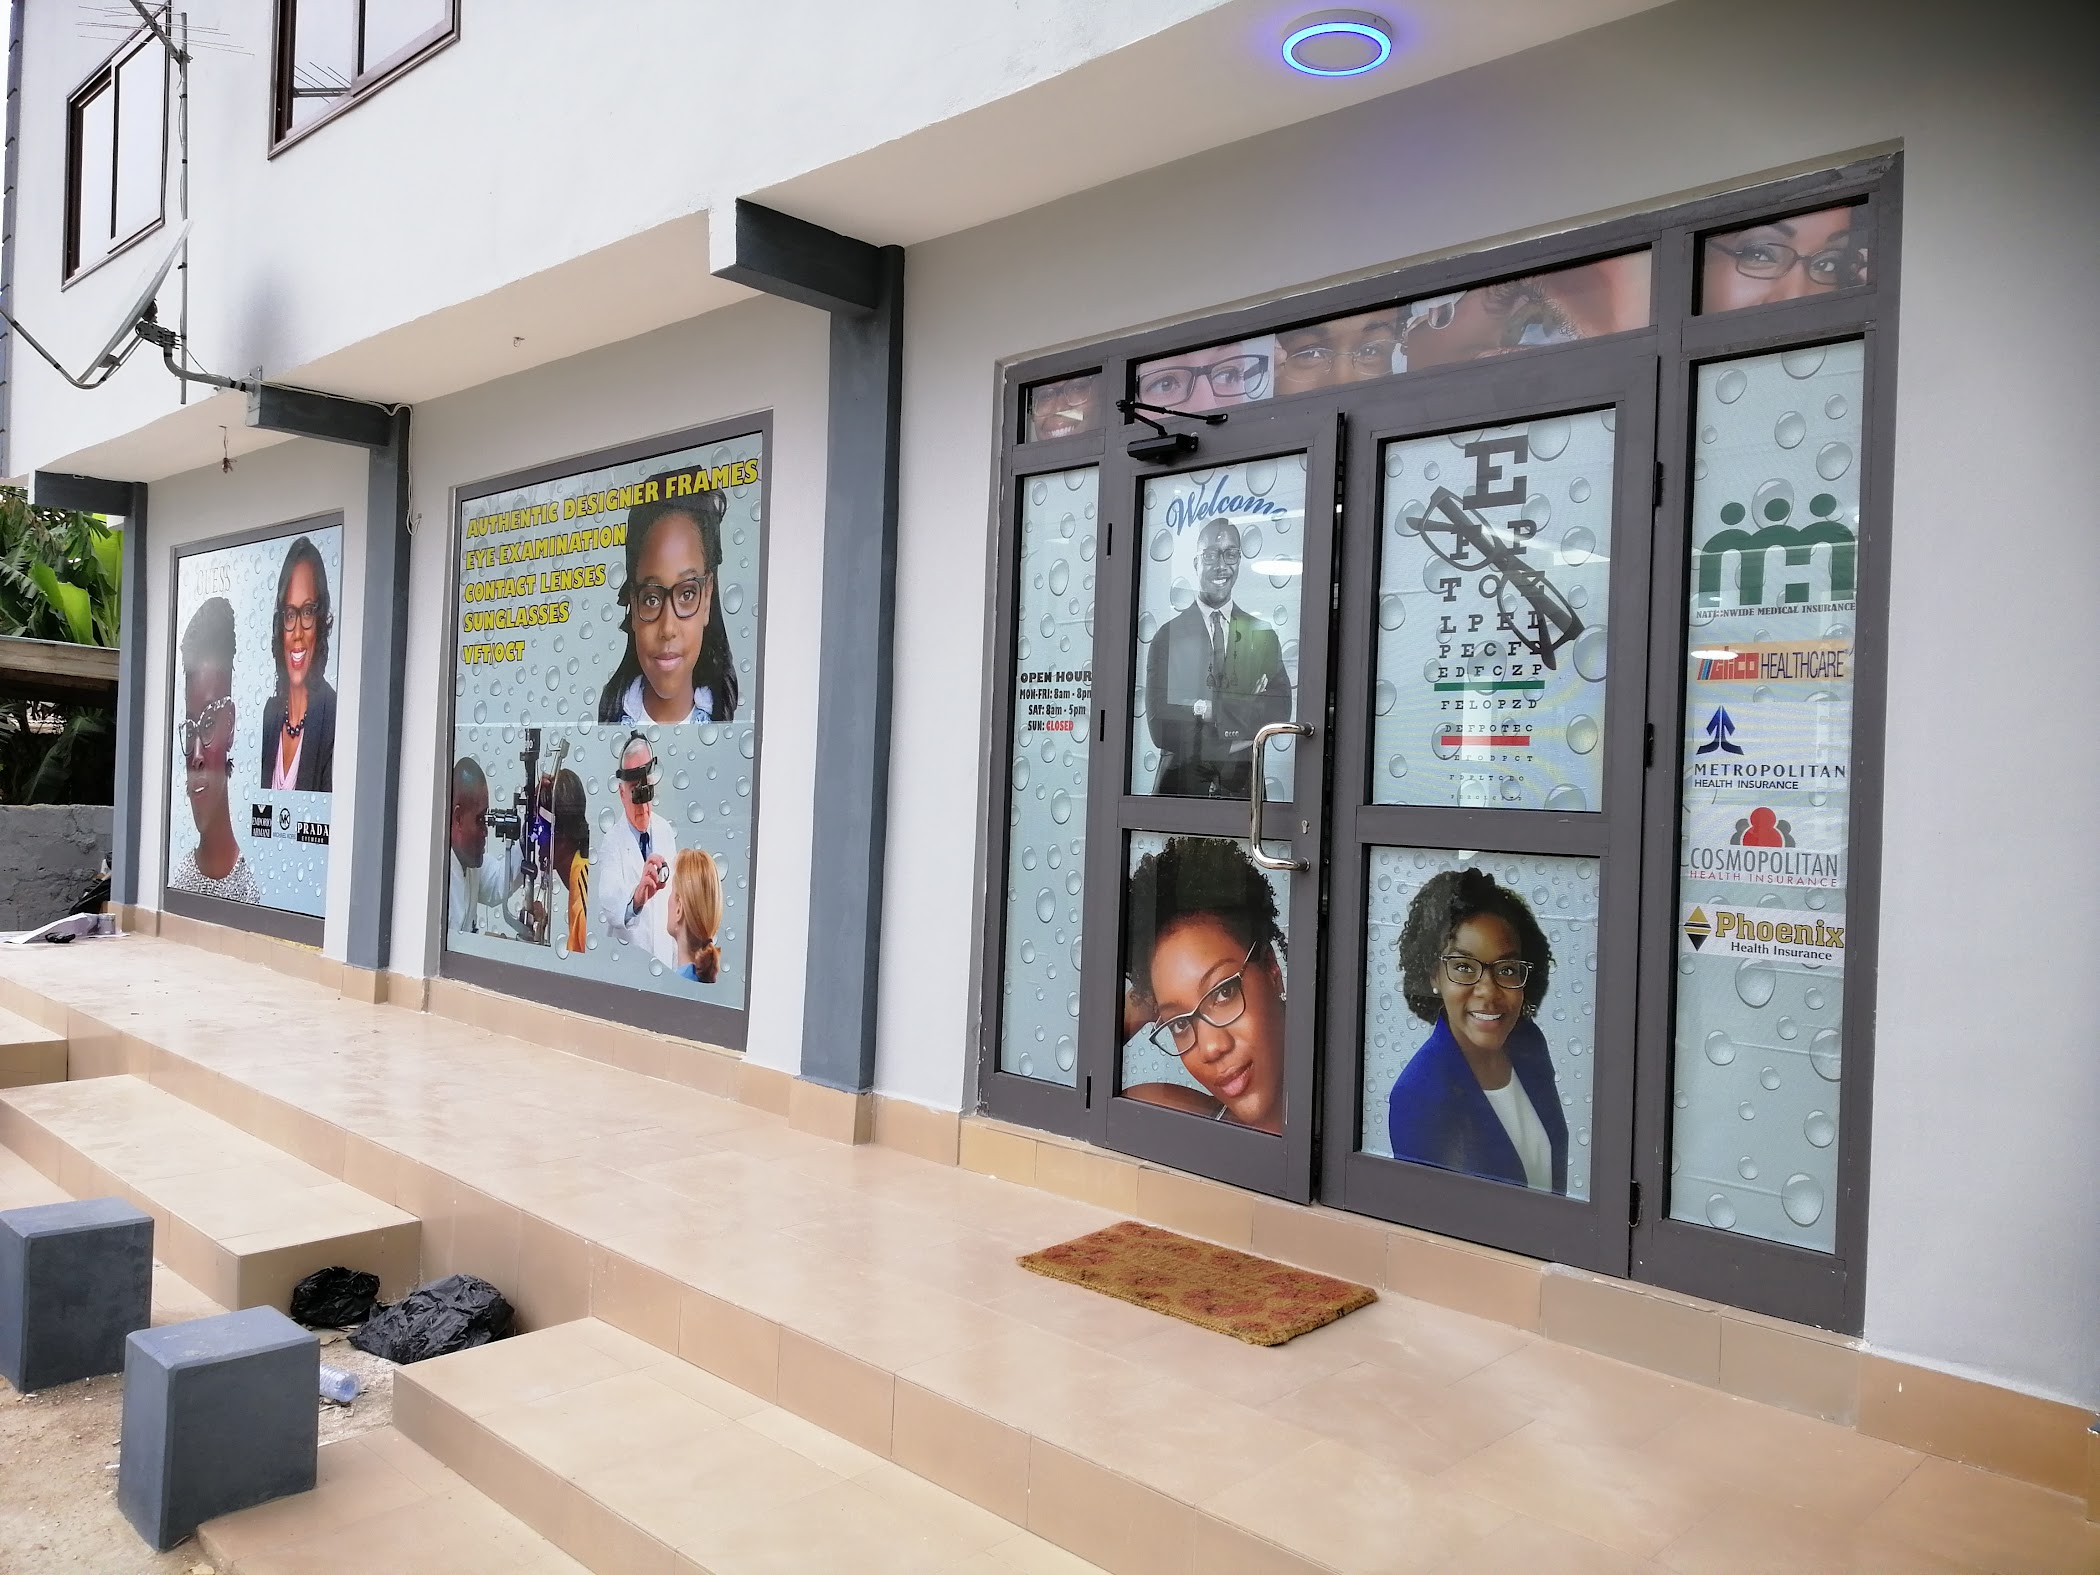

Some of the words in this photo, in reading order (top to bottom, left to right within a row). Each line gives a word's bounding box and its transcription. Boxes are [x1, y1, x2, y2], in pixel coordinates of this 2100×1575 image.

[1463, 435, 1528, 510] E
[466, 501, 559, 539] AUTHENTIC
[563, 480, 659, 520] DESIGNER
[665, 459, 758, 499] FRAMES
[465, 546, 495, 570] EYE
[499, 523, 627, 565] EXAMINATION
[197, 565, 231, 595] GUESS
[464, 574, 536, 603] CONTACT
[540, 564, 606, 593] LENSES
[463, 601, 570, 632] SUNGLASSES
[1757, 604, 1799, 616] MEDICAL
[1802, 602, 1857, 613] INSURANCE
[1760, 650, 1845, 680] HEALTHCARE
[1020, 672, 1052, 683] OPEN
[1054, 688, 1071, 699] 8am
[1028, 704, 1045, 715] SAT:
[1046, 704, 1062, 715] 8am
[1068, 704, 1086, 717] 5pm
[1027, 720, 1045, 731] SUN:
[1046, 720, 1074, 731] CLOSED
[1694, 763, 1846, 778] METROPOLITAN
[1694, 779, 1733, 788] HEALTH
[1737, 780, 1799, 790] INSURANCE
[297, 822, 329, 837] PRADA
[1690, 847, 1838, 877] COSMOPOLITAN
[1689, 870, 1741, 881] HEALTH
[1750, 873, 1837, 888] INSURANCE
[1715, 911, 1845, 949] Phoenix
[1731, 941, 1769, 955] Health
[1773, 945, 1832, 960] Insurance
